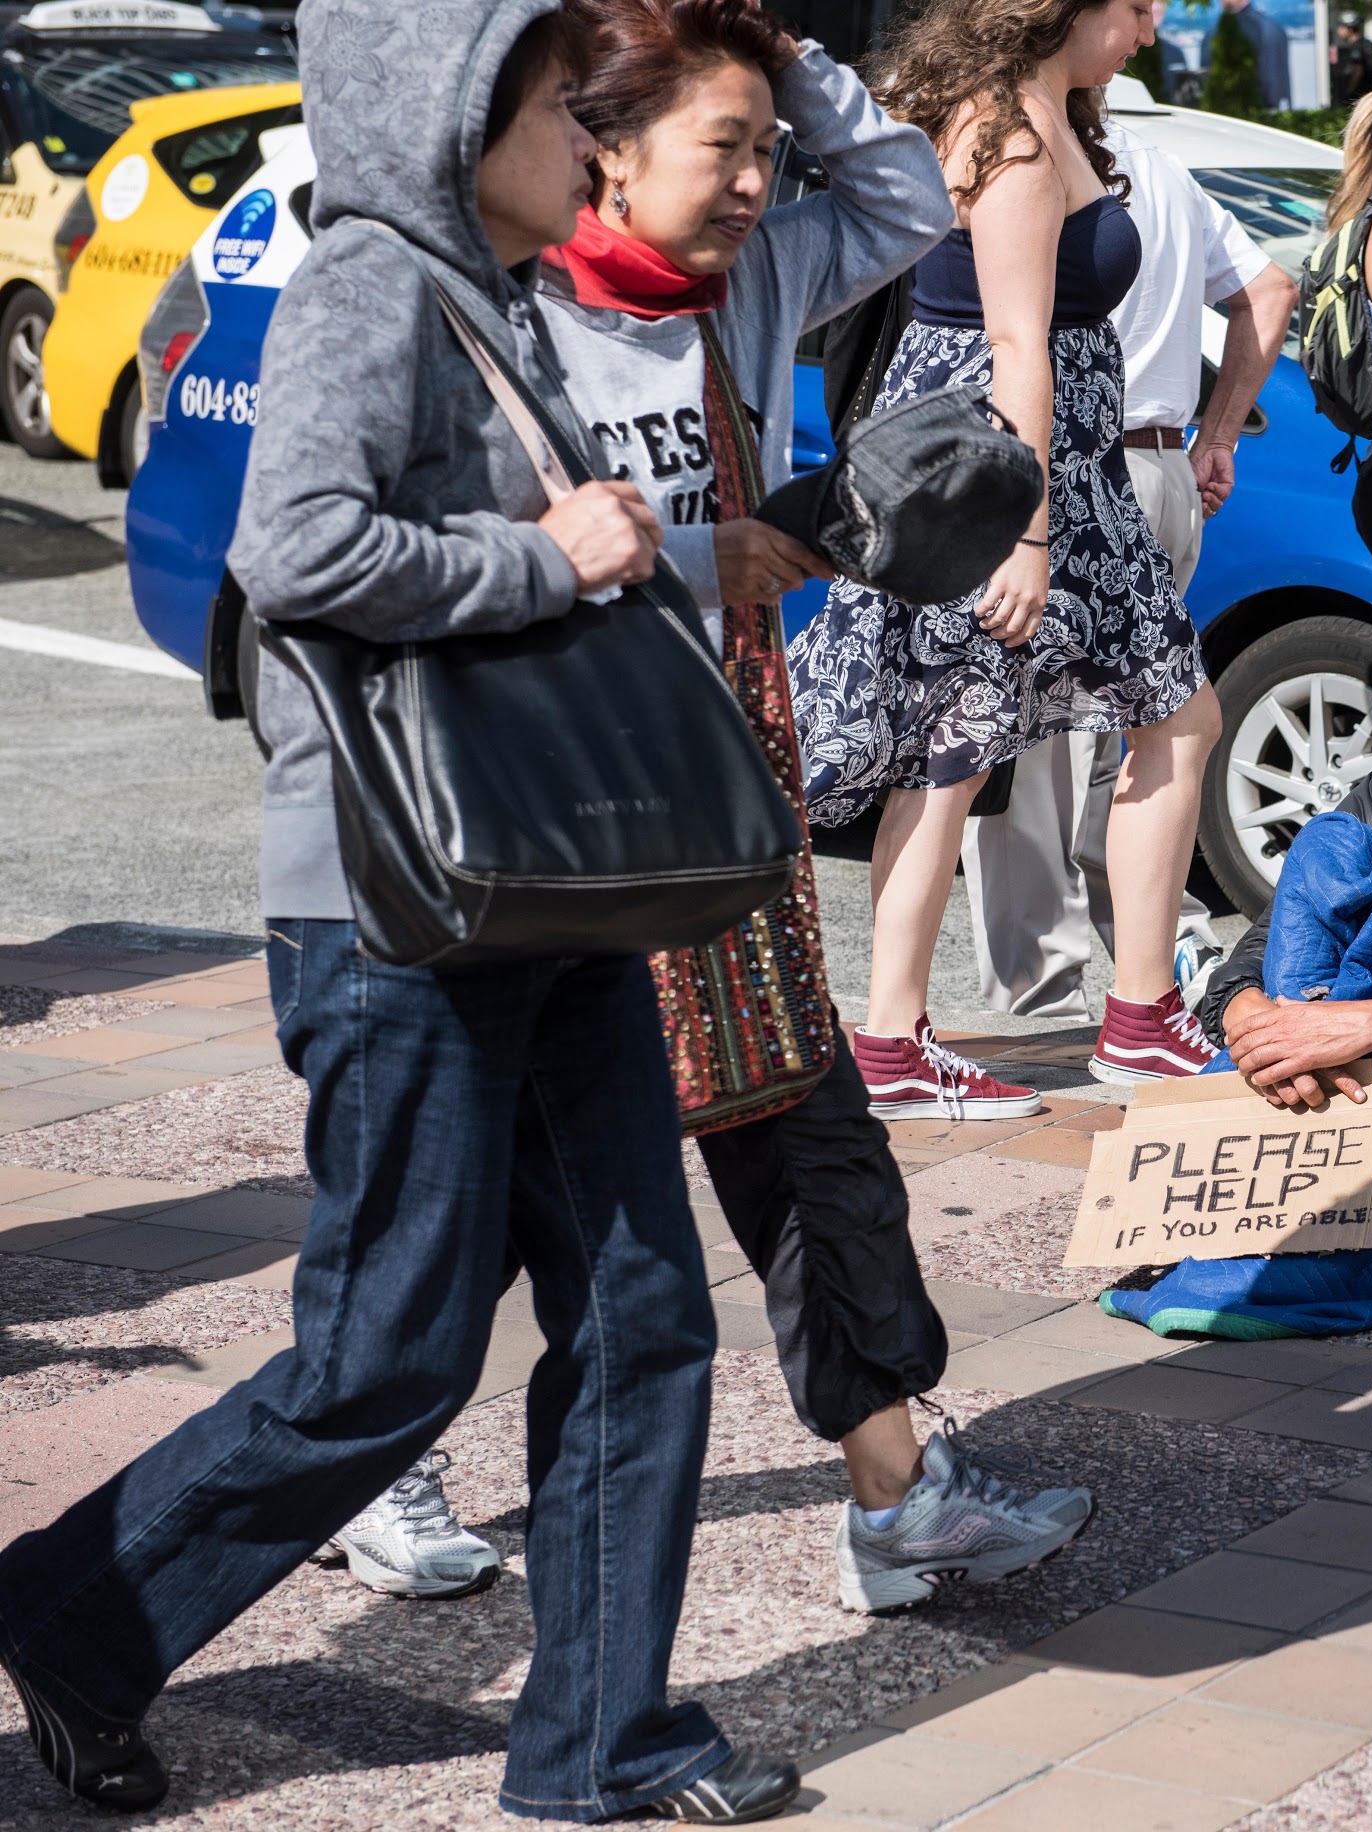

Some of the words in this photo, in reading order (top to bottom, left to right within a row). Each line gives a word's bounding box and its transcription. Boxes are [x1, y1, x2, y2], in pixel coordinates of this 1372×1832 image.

[214, 237, 243, 256] FREE
[216, 256, 251, 274] INSIDE
[1128, 1124, 1372, 1182] PLEASE
[1162, 1172, 1320, 1214] HELP
[1115, 1226, 1146, 1249] IF
[1162, 1219, 1217, 1240] YOU
[1234, 1213, 1288, 1234] ARE
[1299, 1207, 1368, 1226] ABLE
